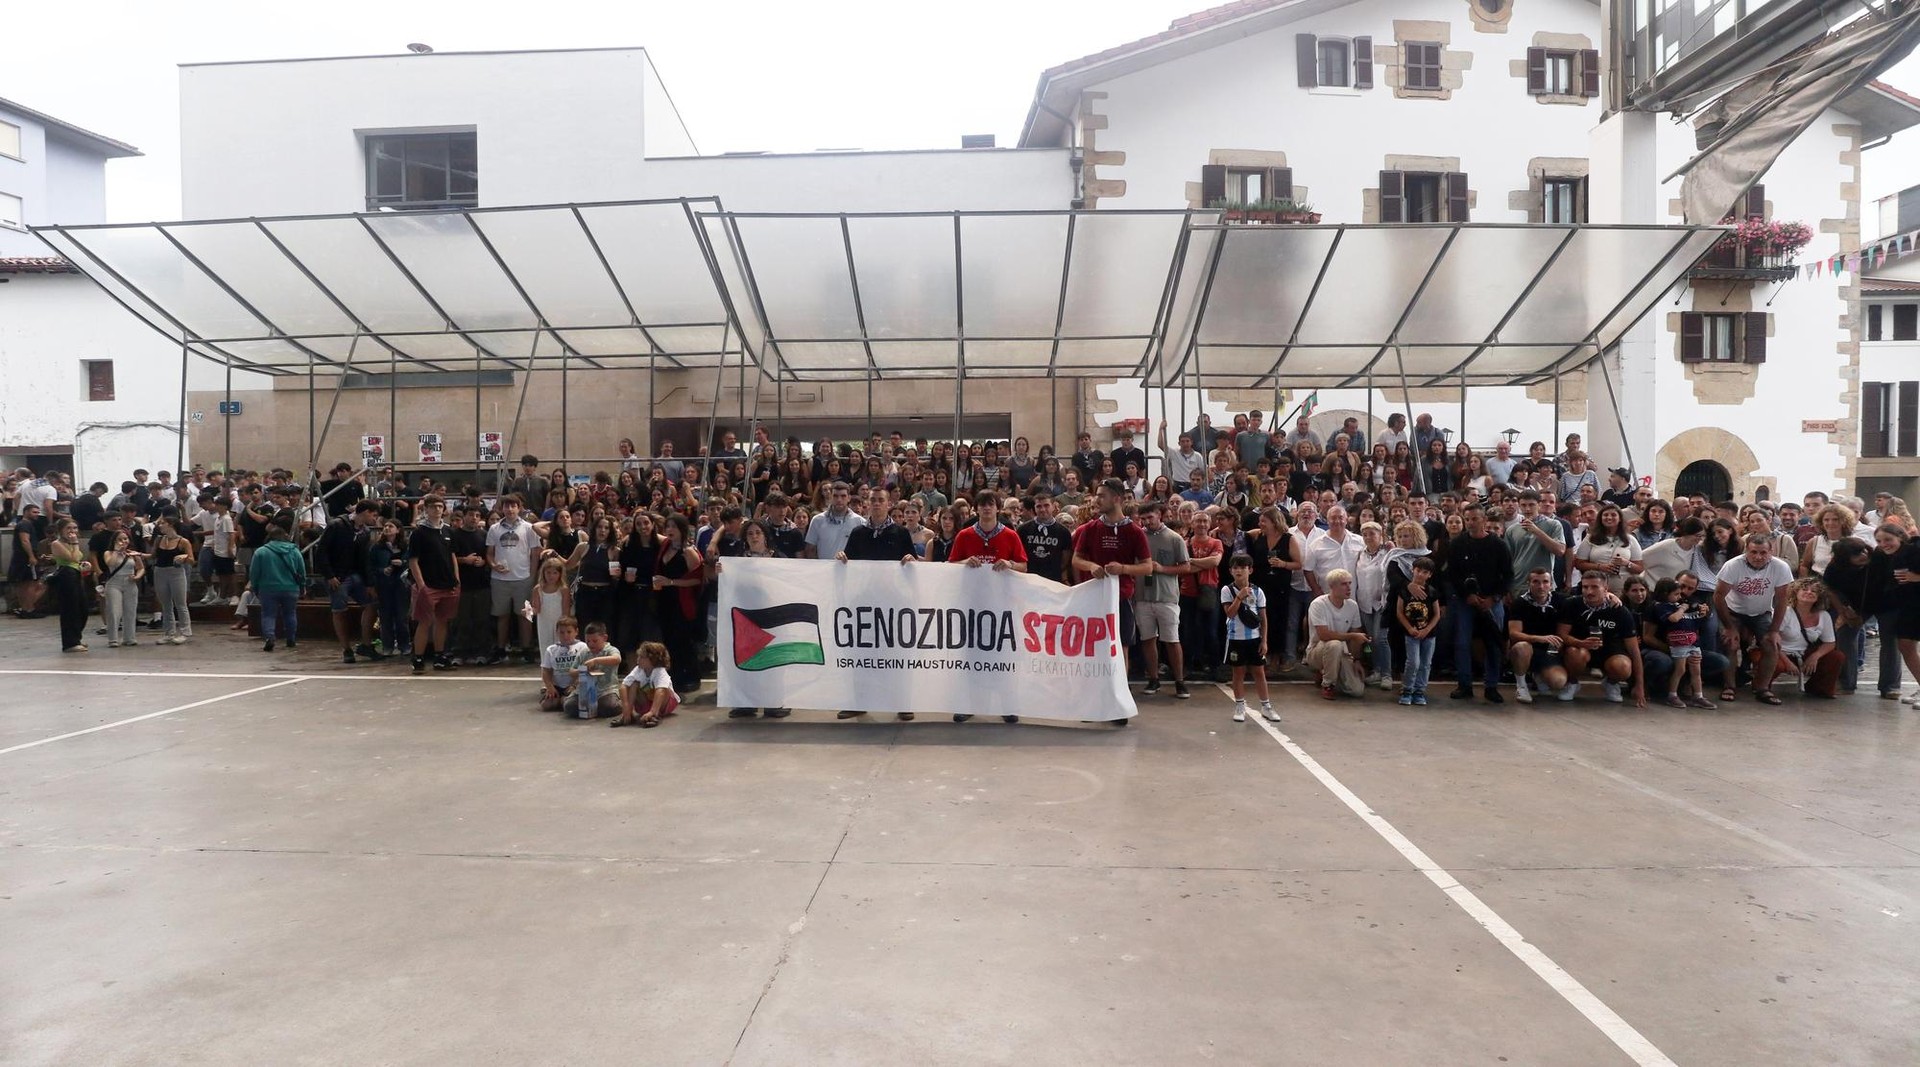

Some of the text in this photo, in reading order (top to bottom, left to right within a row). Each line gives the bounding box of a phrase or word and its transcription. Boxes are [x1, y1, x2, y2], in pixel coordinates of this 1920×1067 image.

[1027, 535, 1059, 546] TALCO
[834, 606, 1117, 657] GENOZIDIOA STOP!
[836, 658, 1016, 673] ISRAELEKIN HAUSTURA ORAIN!
